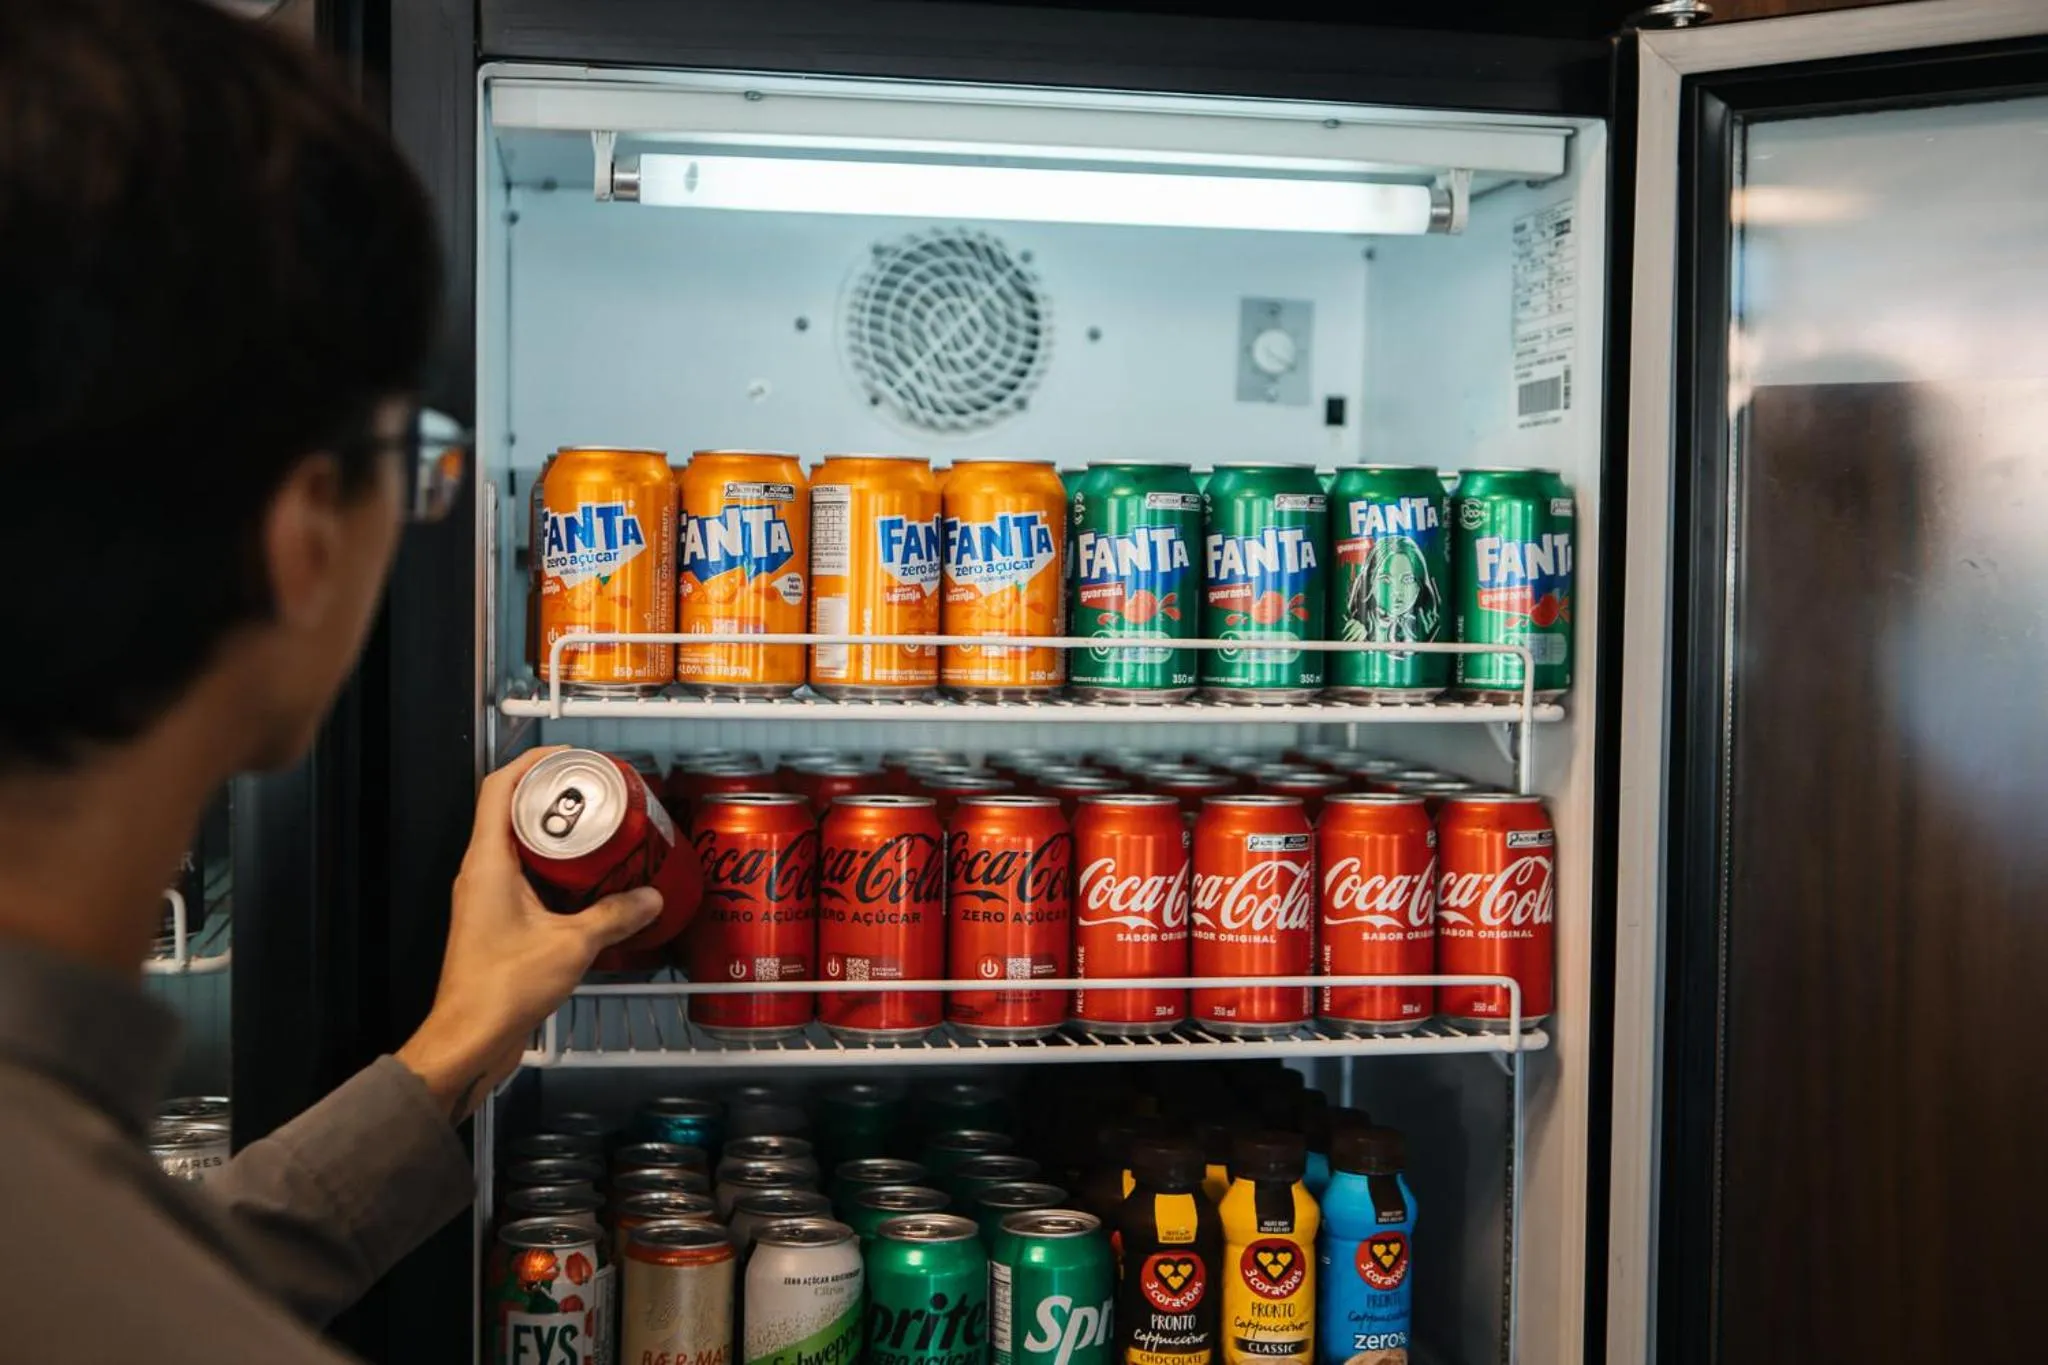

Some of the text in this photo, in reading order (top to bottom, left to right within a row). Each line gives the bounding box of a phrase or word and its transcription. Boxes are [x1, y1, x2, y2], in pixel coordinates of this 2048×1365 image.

[1349, 497, 1439, 535] FANTA
[543, 506, 644, 557] ANTA
[944, 515, 1053, 565] FANTA
[570, 549, 619, 567] açúcar
[1079, 528, 1189, 579] FANTA
[1207, 529, 1317, 581] FANTA
[901, 563, 927, 577] zero
[955, 556, 1036, 577] zero açúcar
[1080, 583, 1123, 602] guaraná
[1208, 584, 1252, 603] guaraná
[1172, 673, 1187, 684] 350
[1300, 673, 1315, 684] 350
[851, 909, 922, 926] AÇÚCAR
[962, 909, 1006, 923] ZERO
[1116, 932, 1158, 942] SABOR
[1219, 933, 1277, 944] ORIGINAL
[1362, 931, 1404, 941] SABOR
[1478, 930, 1534, 939] ORIGINAL
[1251, 1302, 1296, 1319] PRONTO
[1150, 1313, 1197, 1332] PRONTO
[1233, 1315, 1310, 1340] Cappuccino
[512, 1325, 580, 1365] FYS
[1133, 1328, 1209, 1353] Cappuccino
[1247, 1341, 1296, 1355] CLASSIC
